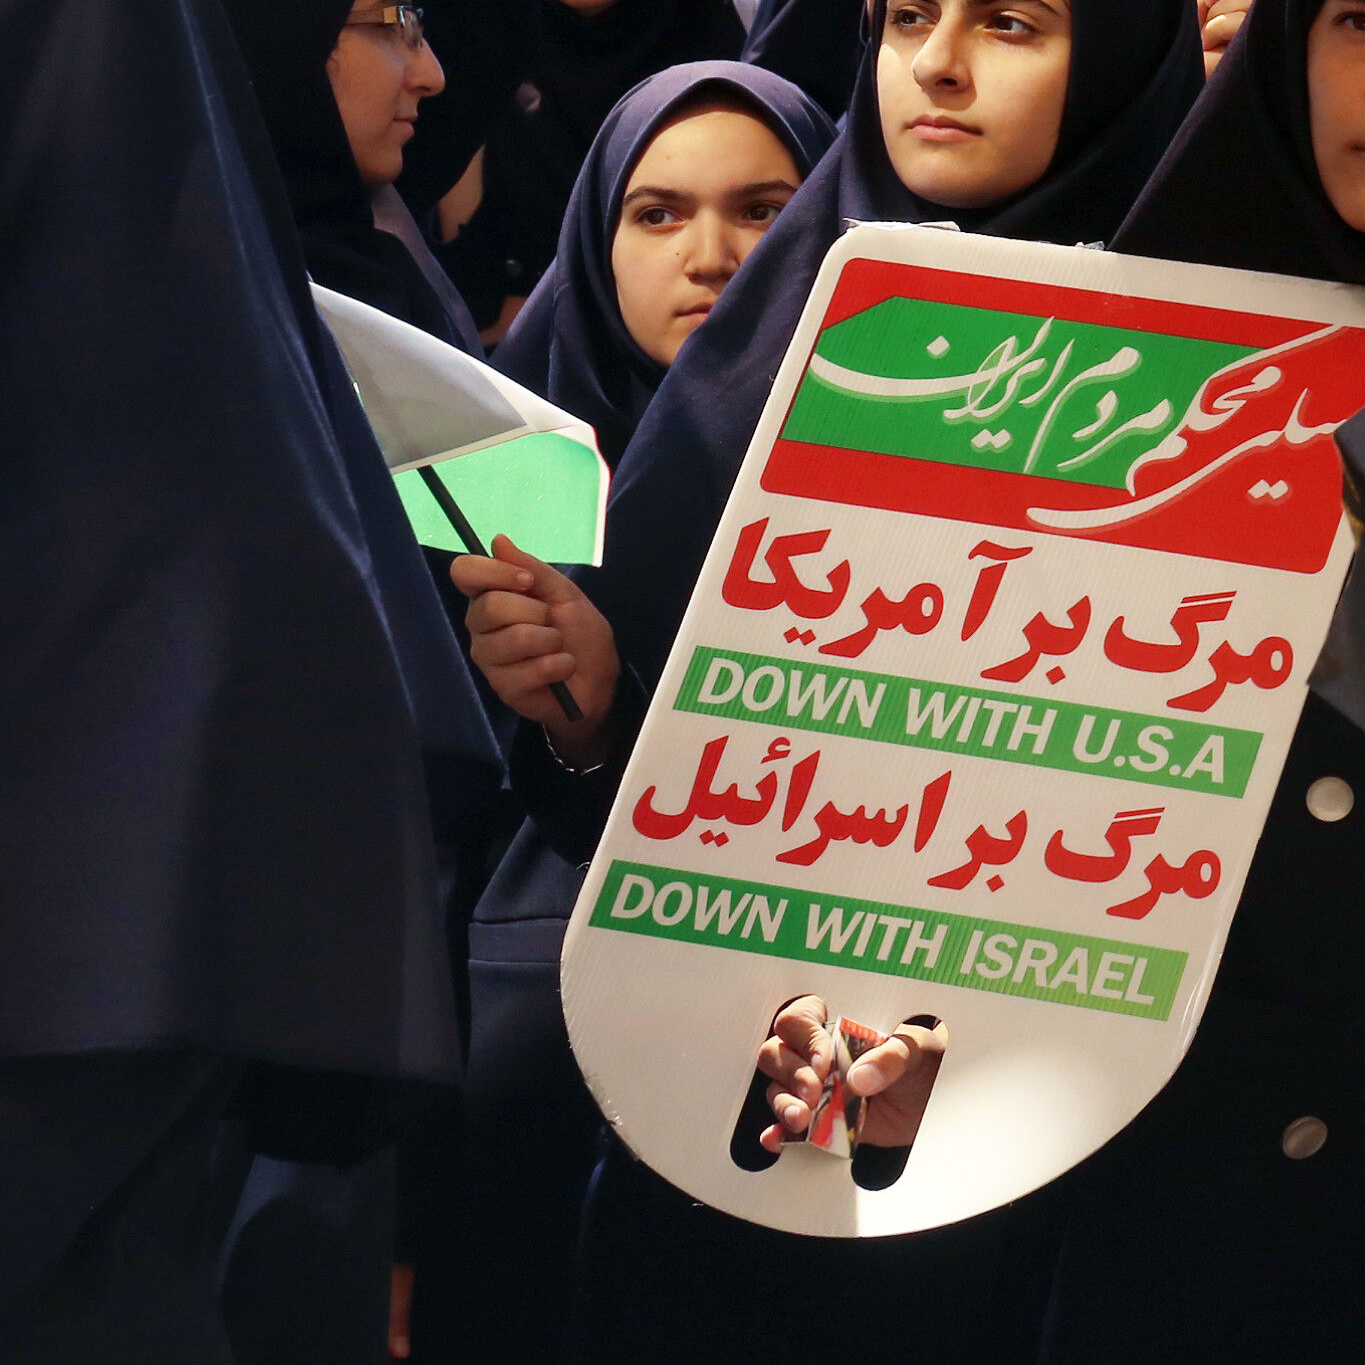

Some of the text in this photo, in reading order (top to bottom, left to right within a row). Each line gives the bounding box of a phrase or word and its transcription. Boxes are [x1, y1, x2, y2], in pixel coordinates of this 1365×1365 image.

[809, 316, 1075, 450] ایران
[1023, 346, 1172, 475] مردم
[1126, 322, 1347, 498] محکم
[720, 515, 1294, 713] مرگ بر آمریکا
[697, 656, 1227, 784] DOWN WITH U.S.A
[631, 734, 1222, 921] مرگ بر اسرائیل
[608, 872, 1156, 1005] DOWN WITH ISRAEL
